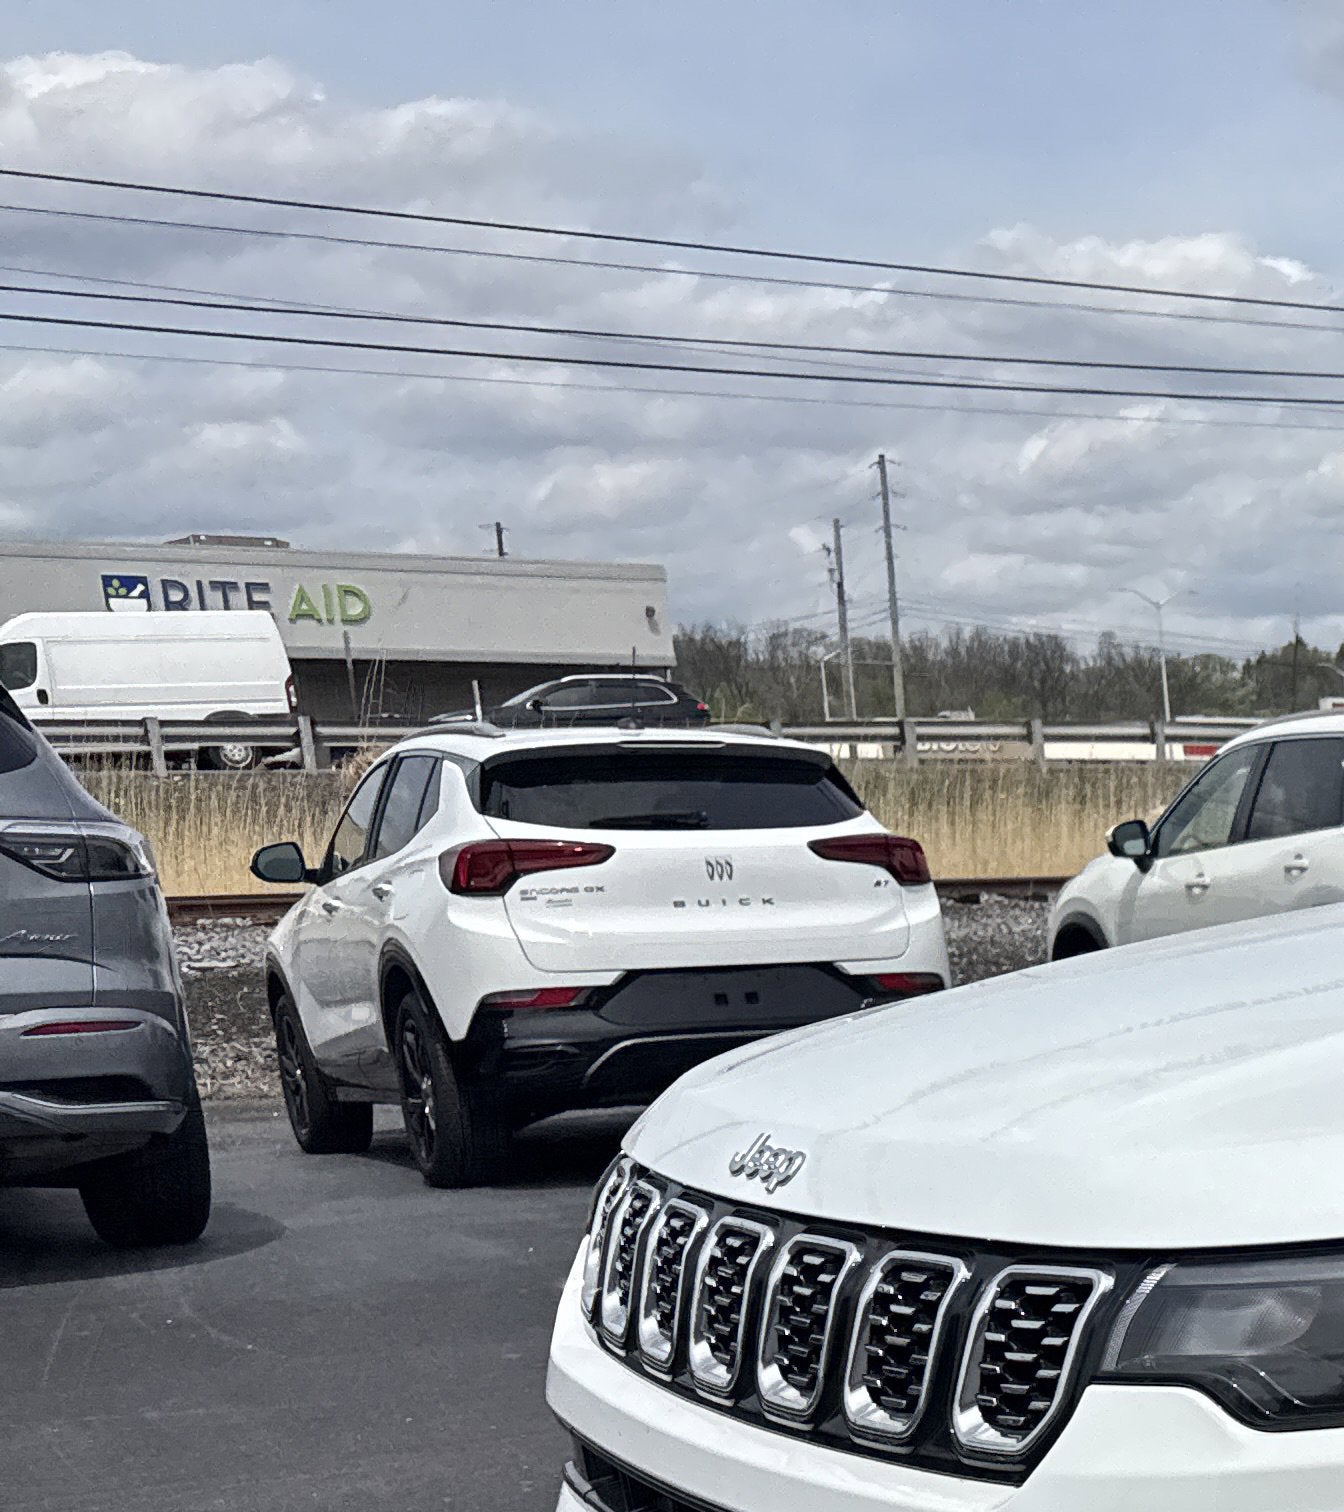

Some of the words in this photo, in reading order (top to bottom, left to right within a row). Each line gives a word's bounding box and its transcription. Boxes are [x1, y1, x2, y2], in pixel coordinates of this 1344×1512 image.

[161, 578, 274, 613] RITE
[287, 582, 372, 624] AID
[673, 898, 775, 908] BUICK
[728, 1132, 807, 1195] Jeep
